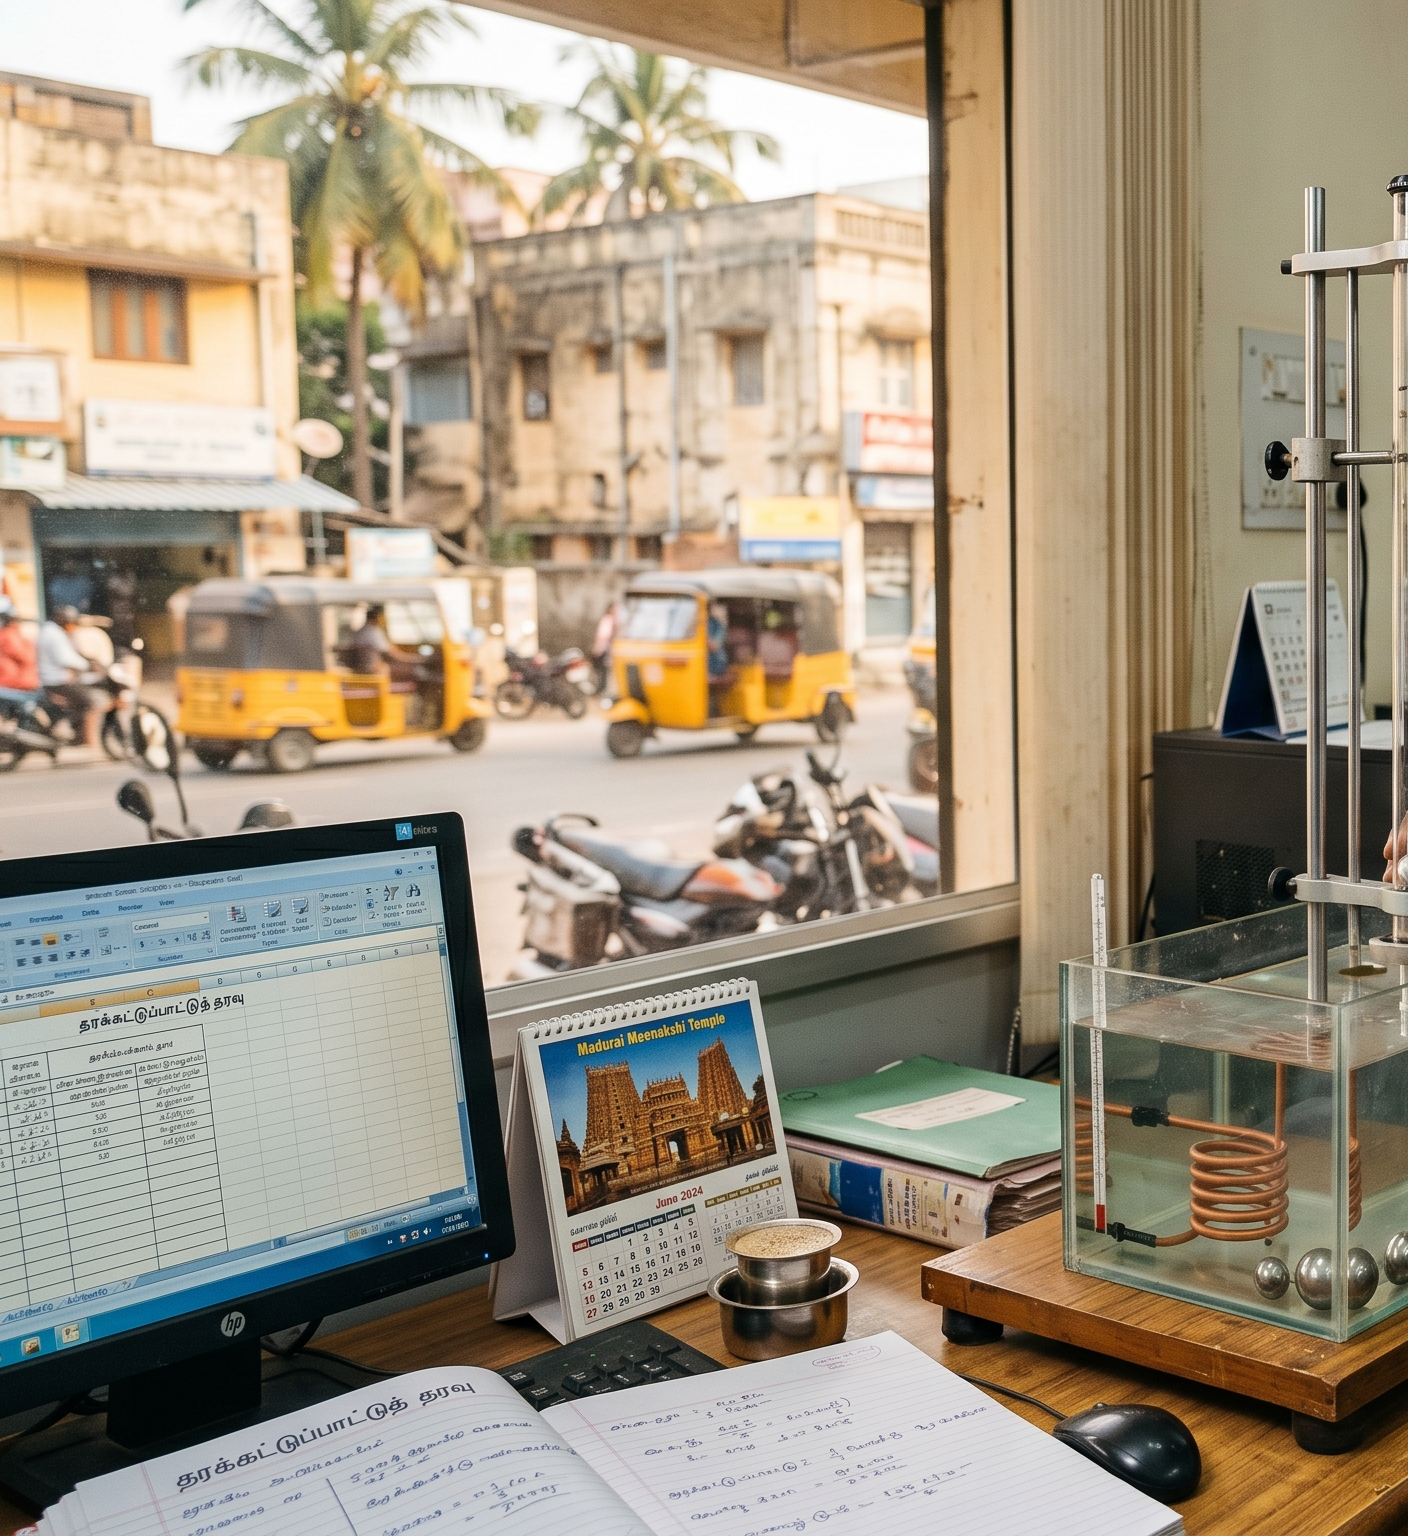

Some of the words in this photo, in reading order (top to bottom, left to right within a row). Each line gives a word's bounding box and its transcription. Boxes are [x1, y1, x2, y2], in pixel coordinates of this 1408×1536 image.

[213, 993, 244, 1010] தரவு
[577, 1034, 625, 1056] Madurai
[627, 1020, 686, 1045] Meenakshi
[688, 1013, 725, 1031] Temple
[681, 1186, 703, 1200] 2024
[627, 1238, 632, 1246] 1
[643, 1233, 649, 1241] 2
[658, 1228, 664, 1236] 3
[673, 1223, 679, 1231] 4
[598, 1262, 604, 1271] 6
[614, 1256, 619, 1265] 7
[630, 1252, 636, 1260] 8
[674, 1236, 683, 1245] 11
[688, 1230, 698, 1240] 12
[614, 1270, 625, 1279] 14
[630, 1264, 640, 1274] 15
[645, 1259, 656, 1268] 16
[661, 1254, 671, 1264] 17
[676, 1248, 686, 1258] 18
[600, 1289, 612, 1299] 20
[632, 1277, 643, 1288] 22
[647, 1272, 658, 1282] 23
[662, 1266, 674, 1277] 24
[678, 1261, 689, 1272] 25
[224, 1312, 243, 1337] hp
[586, 1308, 597, 1318] 27
[176, 1396, 408, 1492] தரக்கட்டுப்பாட்டுத்
[419, 1382, 475, 1407] தரவு
